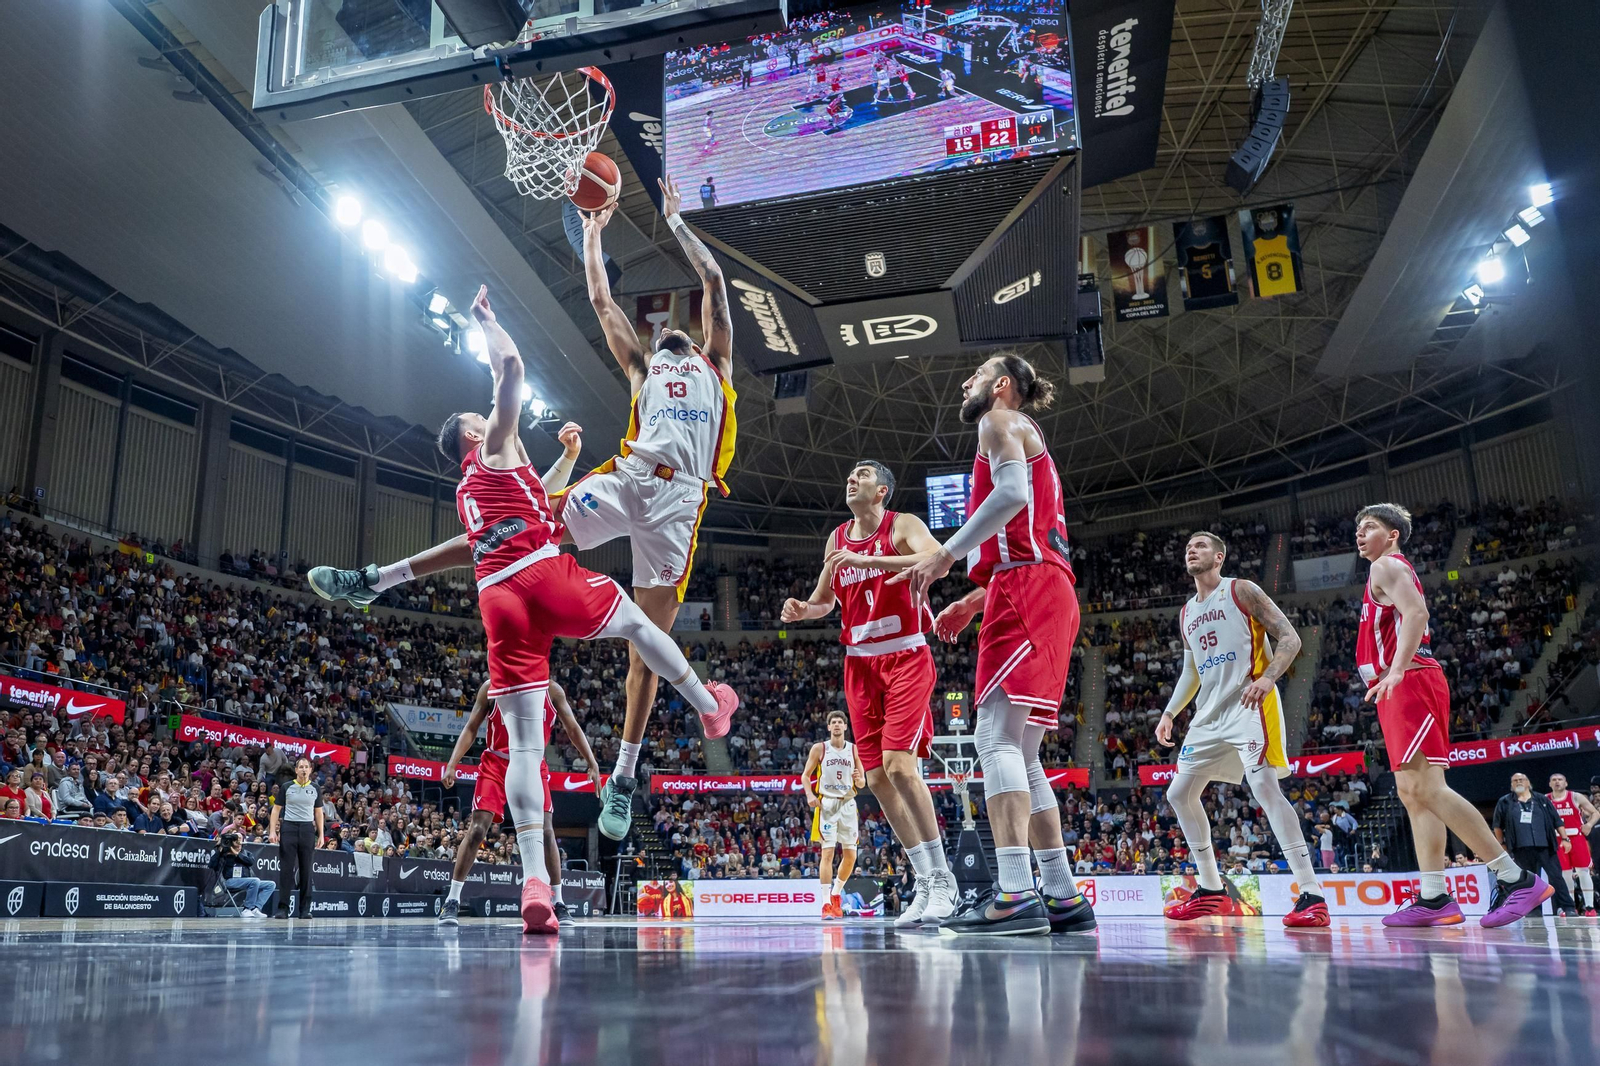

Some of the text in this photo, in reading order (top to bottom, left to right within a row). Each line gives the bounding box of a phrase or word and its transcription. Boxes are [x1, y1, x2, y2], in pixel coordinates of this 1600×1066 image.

[1095, 29, 1109, 113] despierta emociones
[1096, 18, 1139, 117] tenerife!
[998, 119, 1010, 130] GEO
[1022, 113, 1048, 125] 47.6
[1028, 125, 1042, 135] 1T
[954, 137, 973, 151] 15
[989, 131, 1010, 146] 22
[1266, 262, 1283, 281] 8
[650, 362, 702, 375] SPAÑA
[665, 381, 687, 398] 13
[649, 406, 709, 427] endesa
[865, 589, 874, 612] 9
[1187, 609, 1227, 636] ESPAÑA
[1199, 630, 1218, 651] 35
[9, 685, 61, 710] tenerife!
[946, 692, 963, 701] 47.3
[419, 710, 443, 722] DXT
[951, 704, 961, 717] 5
[274, 739, 307, 754] tenerife!
[1449, 736, 1573, 762] desa CaixaBank
[395, 763, 432, 777] endesa
[826, 759, 851, 768] ESPAÑA
[836, 771, 842, 780] 5
[662, 778, 787, 790] endesa CaixaBank tenerife!
[30, 838, 89, 859] endesa
[117, 847, 158, 863] CaixaBank
[312, 862, 340, 875] CaixaBank
[423, 868, 450, 881] endesa
[96, 893, 159, 902] SELECCIÓN ESPAÑOLA
[700, 893, 815, 903] STORE.FEB.ES
[1100, 889, 1144, 902] STORE
